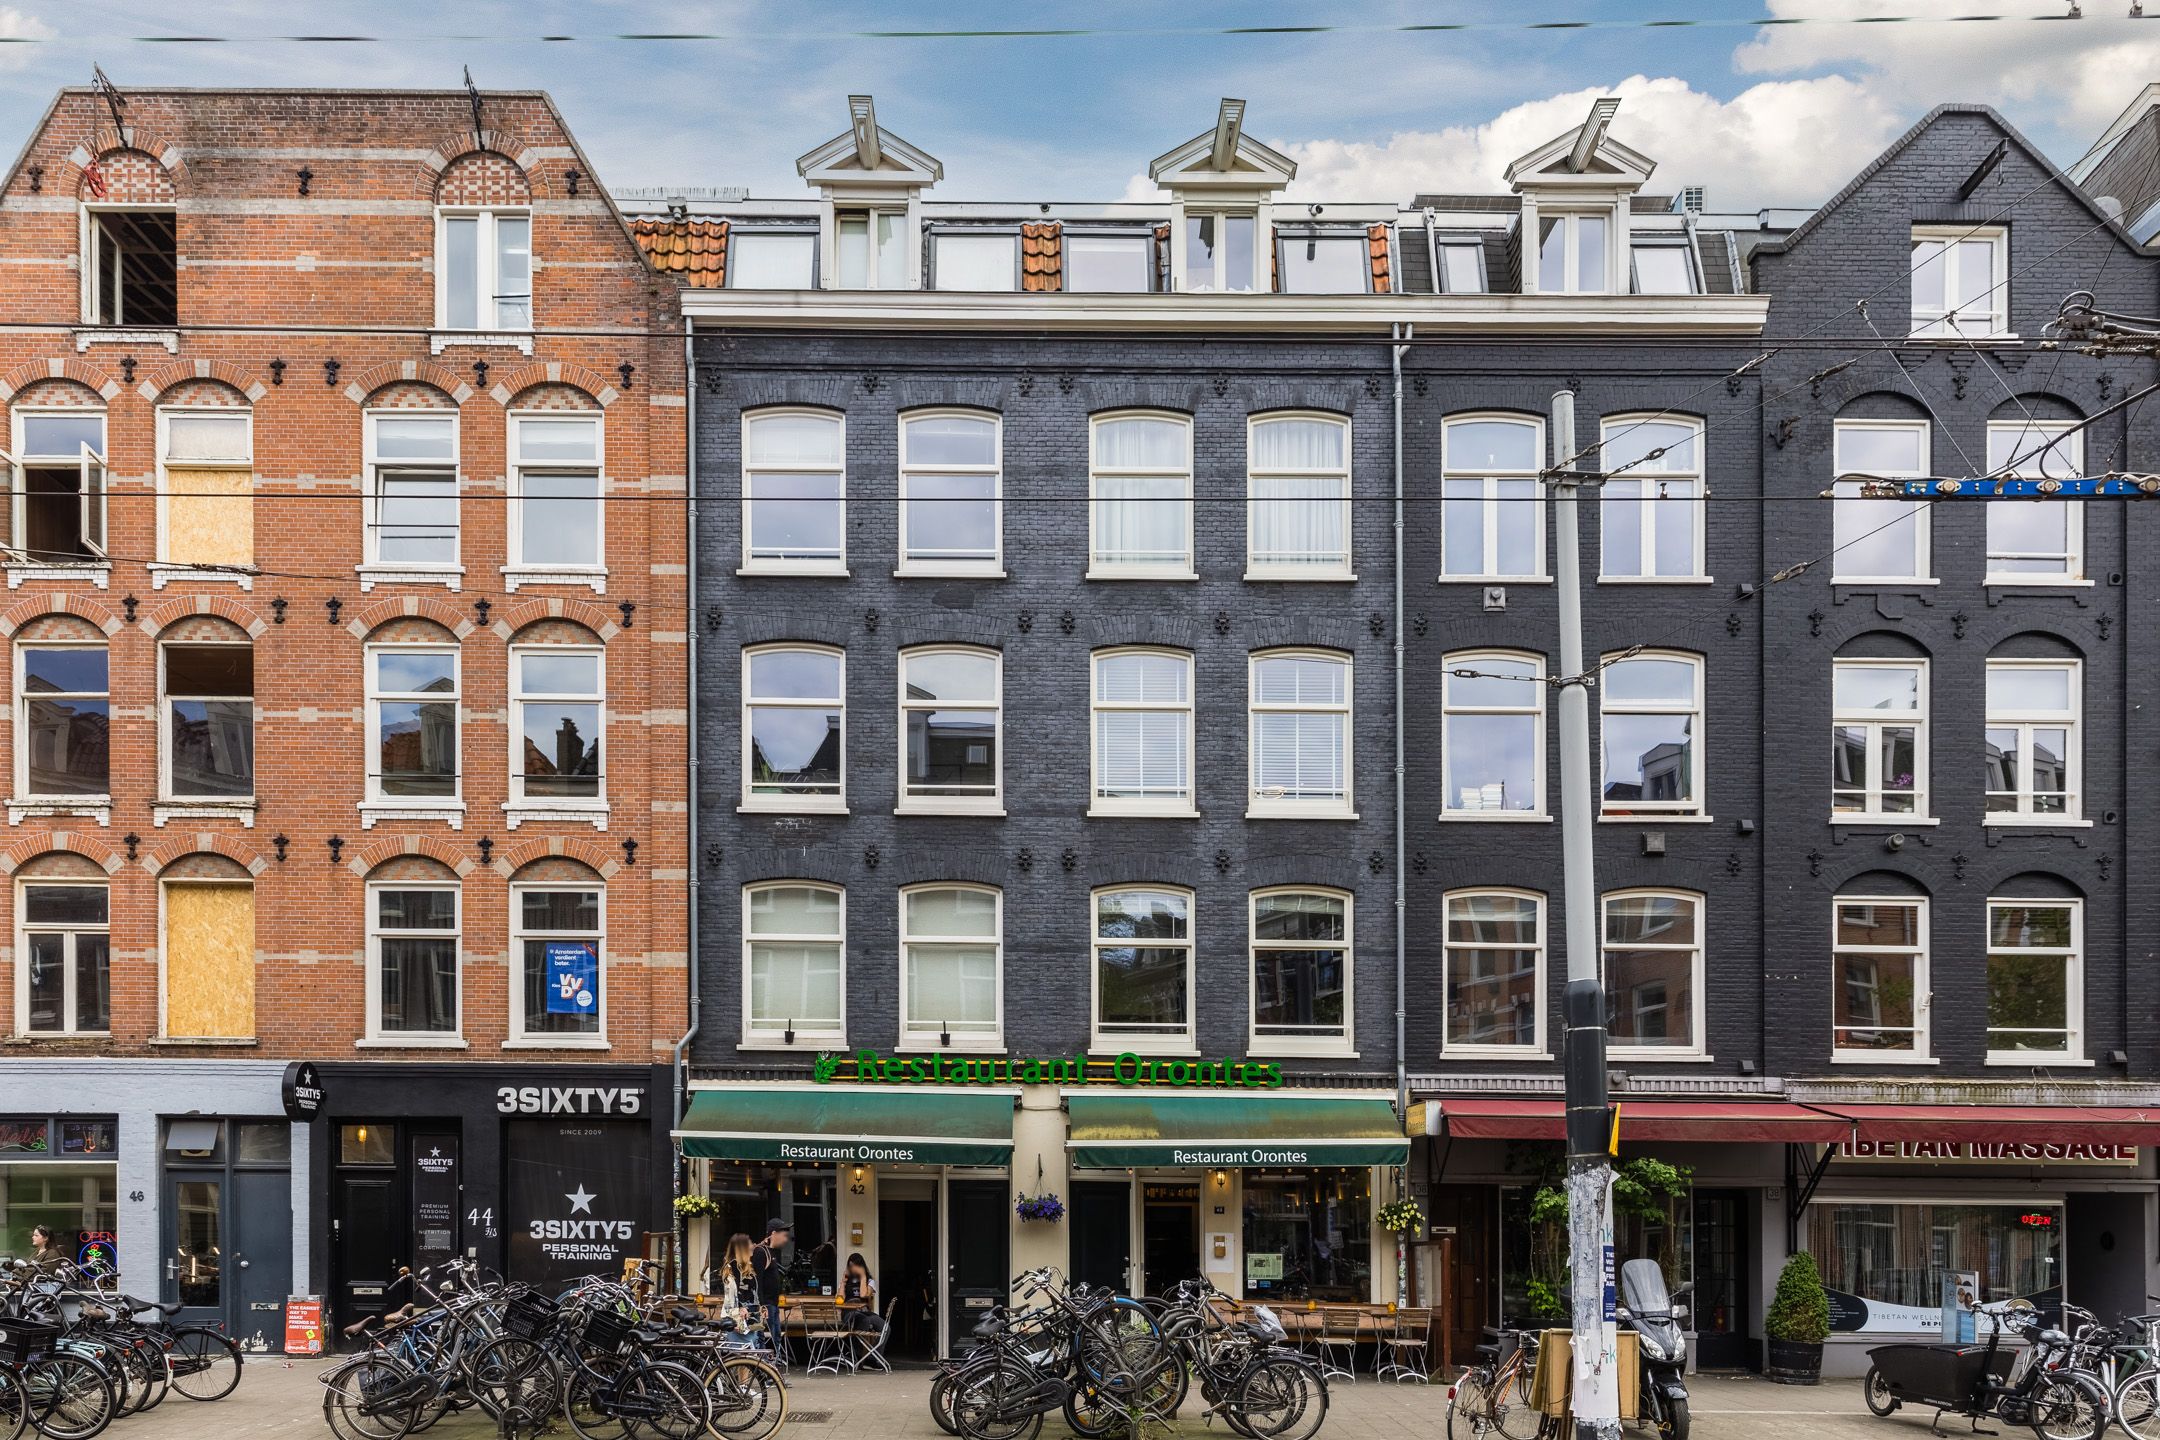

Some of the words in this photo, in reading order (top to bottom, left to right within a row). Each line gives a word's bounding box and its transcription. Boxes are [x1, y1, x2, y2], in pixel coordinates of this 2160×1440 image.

[857, 1050, 1088, 1083] Restaurant
[1113, 1052, 1283, 1088] Orontes
[295, 1086, 321, 1100] 3SIXTY5
[780, 1144, 855, 1158] Restaurant
[858, 1146, 914, 1160] Orontes
[1173, 1150, 1249, 1163] Restaurant
[1251, 1149, 1308, 1163] Orontes
[1969, 1143, 2138, 1160] MASSAGE
[417, 1158, 454, 1166] 3SIXTY5
[850, 1184, 865, 1195] 42
[129, 1190, 145, 1202] 46
[467, 1207, 494, 1226] 44
[2021, 1215, 2051, 1225] OPEN
[80, 1231, 118, 1242] OPEN
[542, 1243, 619, 1252] PERSONAL
[550, 1252, 612, 1260] TRAINING
[80, 1276, 118, 1288] NAILS
